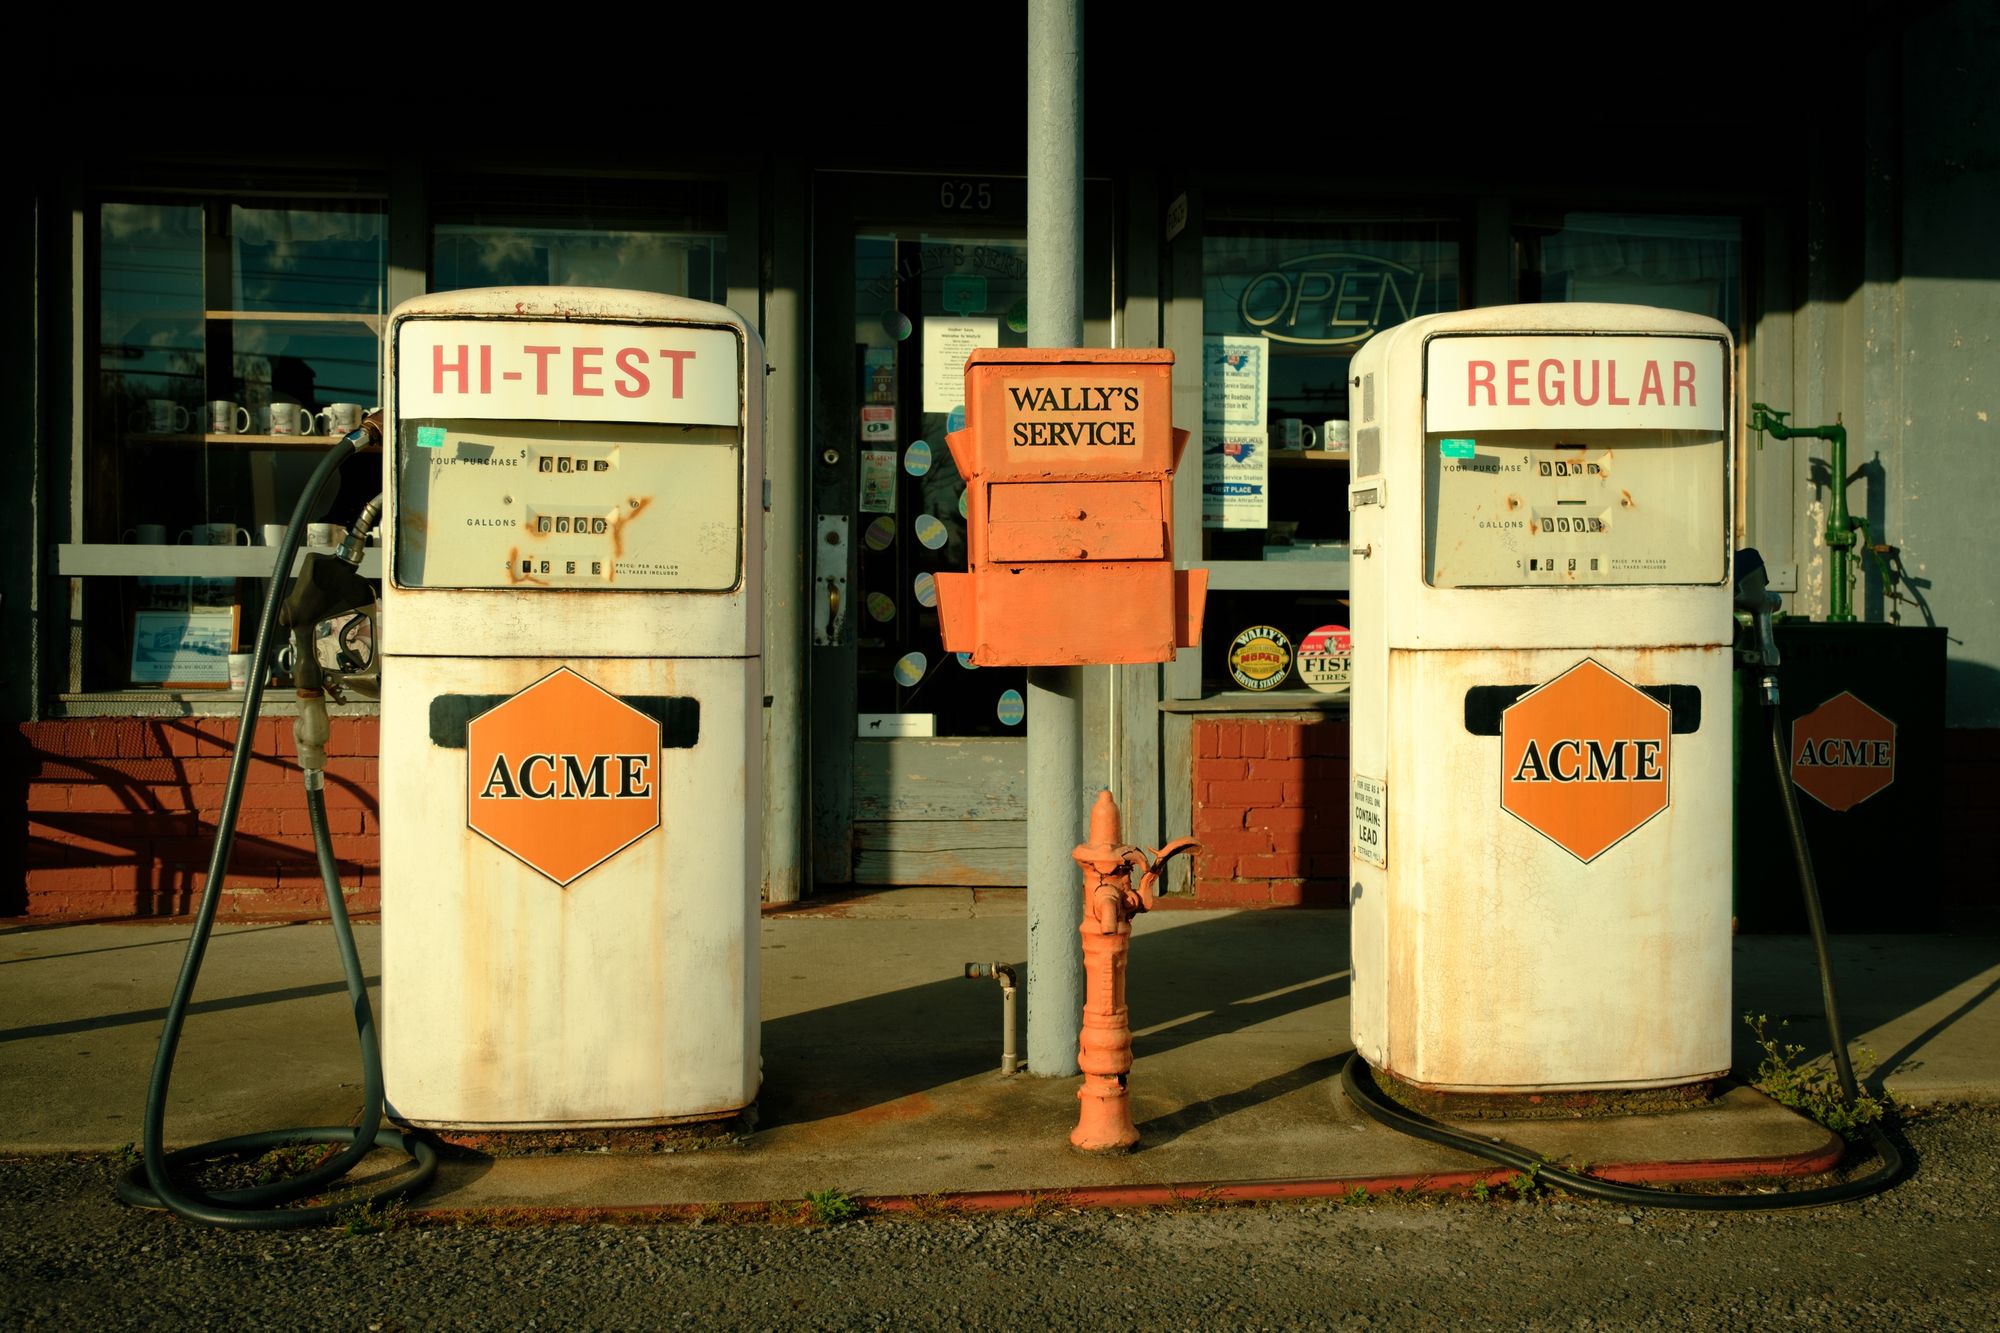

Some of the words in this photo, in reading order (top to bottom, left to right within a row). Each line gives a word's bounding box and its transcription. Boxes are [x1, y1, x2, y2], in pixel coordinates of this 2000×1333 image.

[940, 181, 992, 210] 625
[1241, 271, 1424, 327] OPEN
[432, 345, 697, 399] HI-TEST
[1467, 358, 1697, 407] REGULAR
[1009, 387, 1139, 411] WALLY'S
[1013, 421, 1136, 446] SERVICE
[430, 457, 457, 466] YOUR
[463, 457, 518, 467] PURCHASE
[1443, 464, 1468, 473] YOUR
[1473, 464, 1522, 473] PURCHASE
[466, 518, 517, 528] GALLONS
[1479, 520, 1524, 529] GALLONS
[1236, 628, 1287, 647] WALLY'S
[1240, 652, 1280, 664] MOPAR
[1235, 670, 1259, 689] SERVICE
[1259, 670, 1286, 689] STATION
[1313, 673, 1347, 681] TIRES
[1511, 739, 1662, 783] ACME
[1796, 738, 1891, 768] ACME
[480, 753, 652, 799] ACME
[1359, 824, 1378, 846] LEAD
